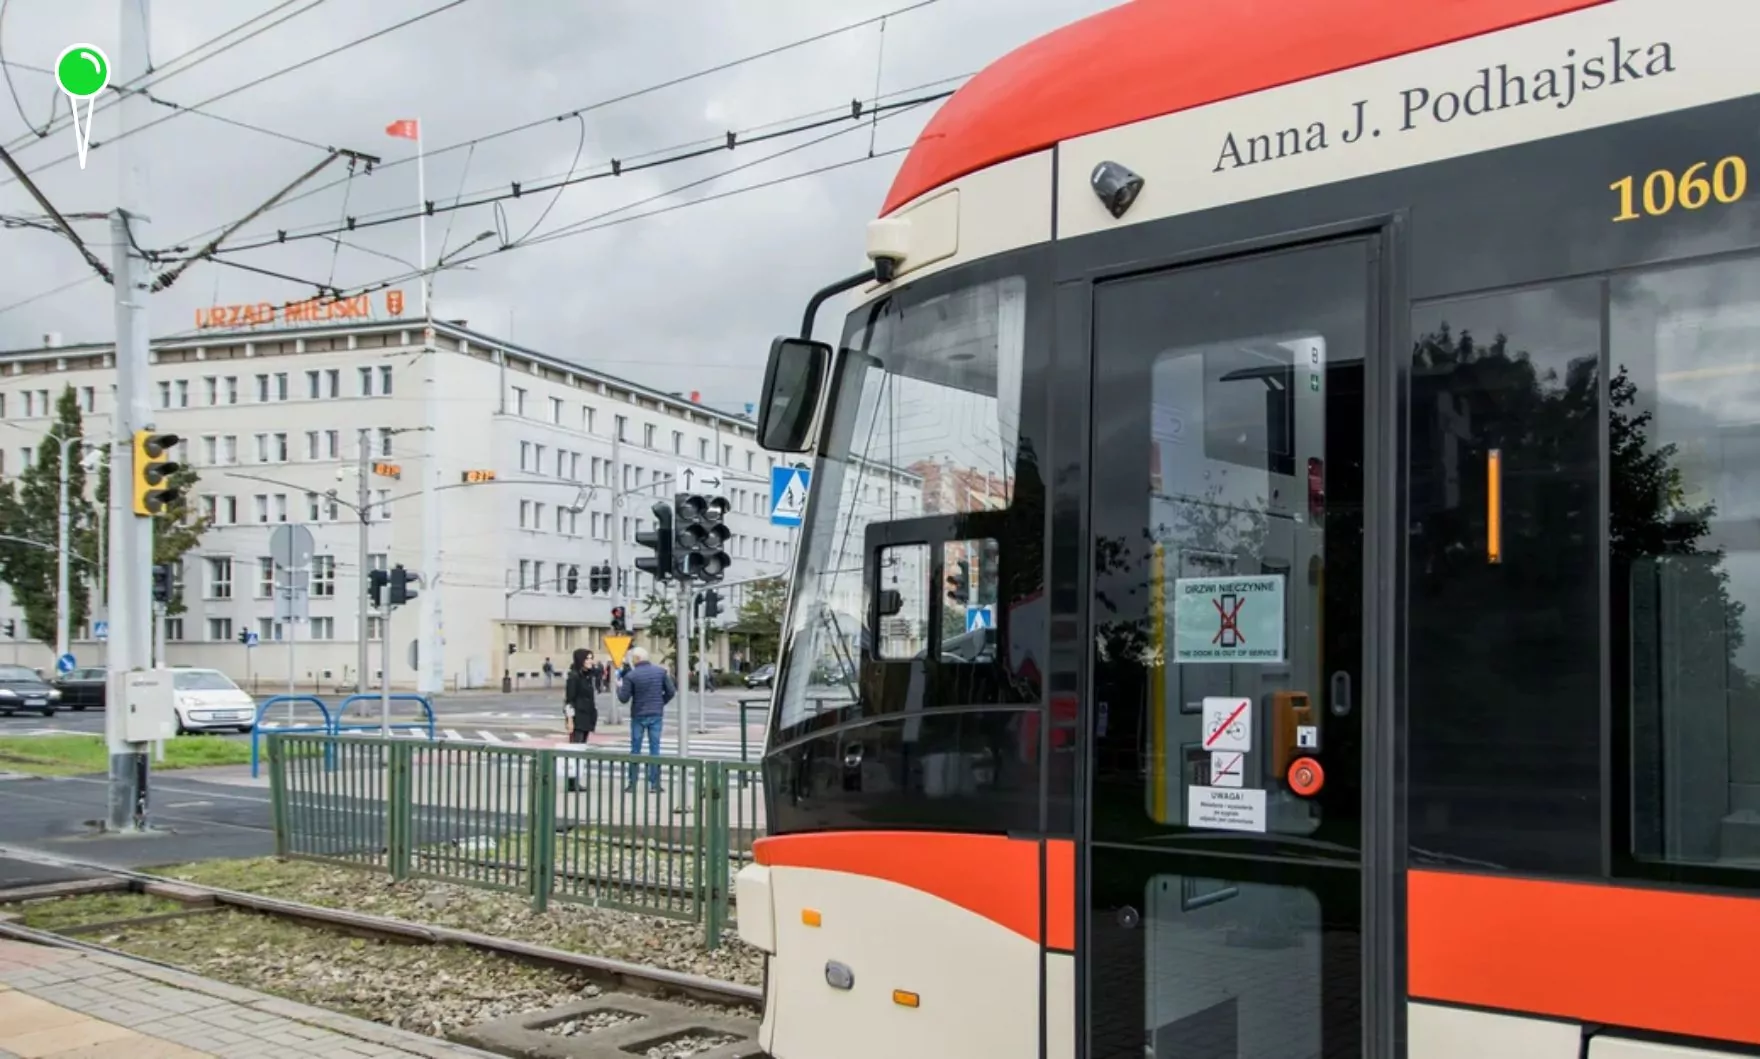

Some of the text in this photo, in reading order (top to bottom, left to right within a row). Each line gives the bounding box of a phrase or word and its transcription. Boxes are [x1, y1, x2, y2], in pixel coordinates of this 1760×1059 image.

[1213, 37, 1676, 172] Anna J. Podhajska
[1609, 155, 1748, 222] 1060
[285, 295, 368, 321] MIEJSKI
[1185, 581, 1275, 594] DRZWI NIECZYNNE
[1249, 649, 1278, 657] SERVICE
